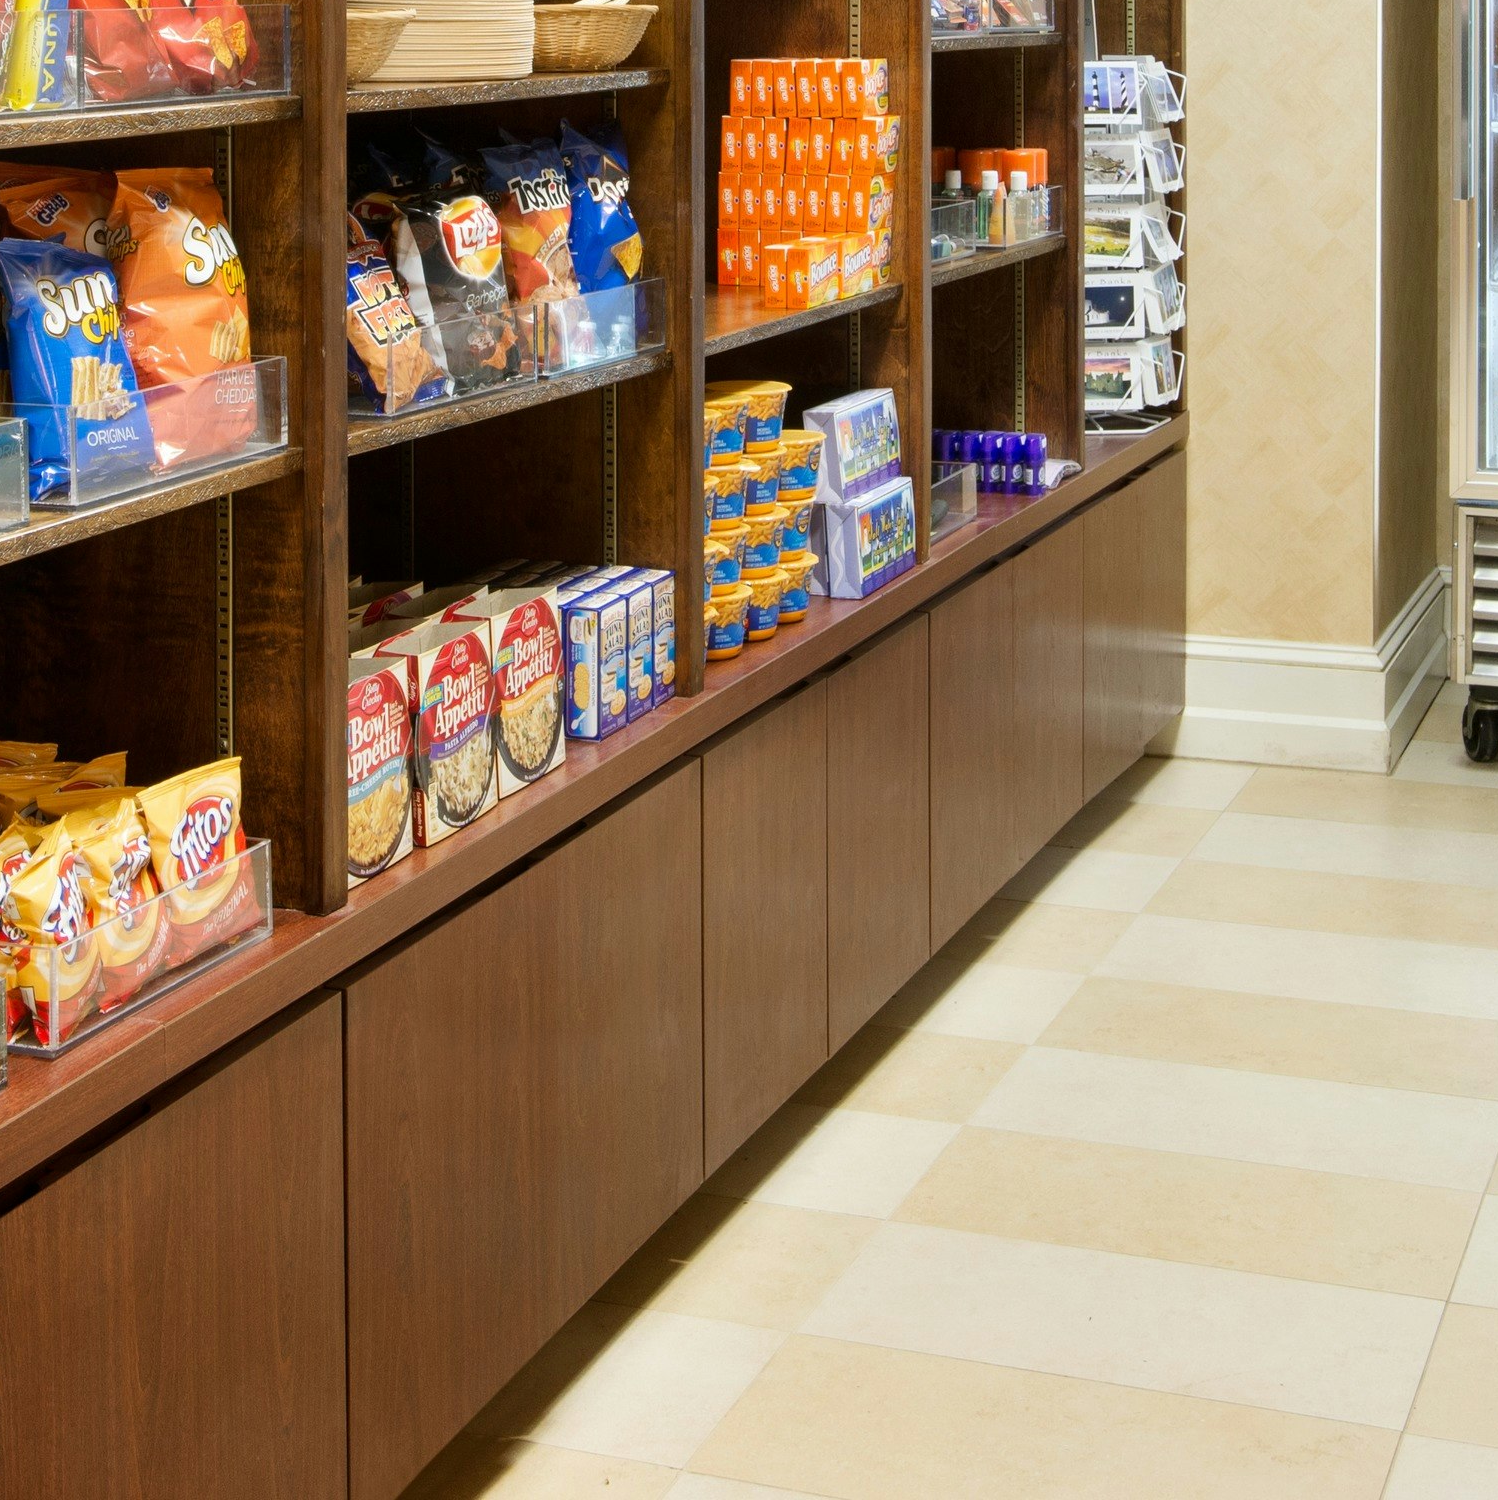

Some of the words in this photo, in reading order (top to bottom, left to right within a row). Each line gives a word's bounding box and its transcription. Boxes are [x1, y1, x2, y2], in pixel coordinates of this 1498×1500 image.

[182, 216, 239, 288] Sun
[451, 205, 500, 259] Lay's
[535, 227, 565, 263] CRISPY
[37, 271, 118, 339] Sun
[87, 425, 140, 447] ORIGINAL
[512, 626, 544, 672] Bowl
[604, 634, 625, 652] SALAD
[605, 626, 623, 641] TUNA
[442, 663, 477, 708] Bowl
[349, 702, 391, 752] Bowl
[444, 736, 460, 752] PASTA
[169, 797, 232, 891] Fritos
